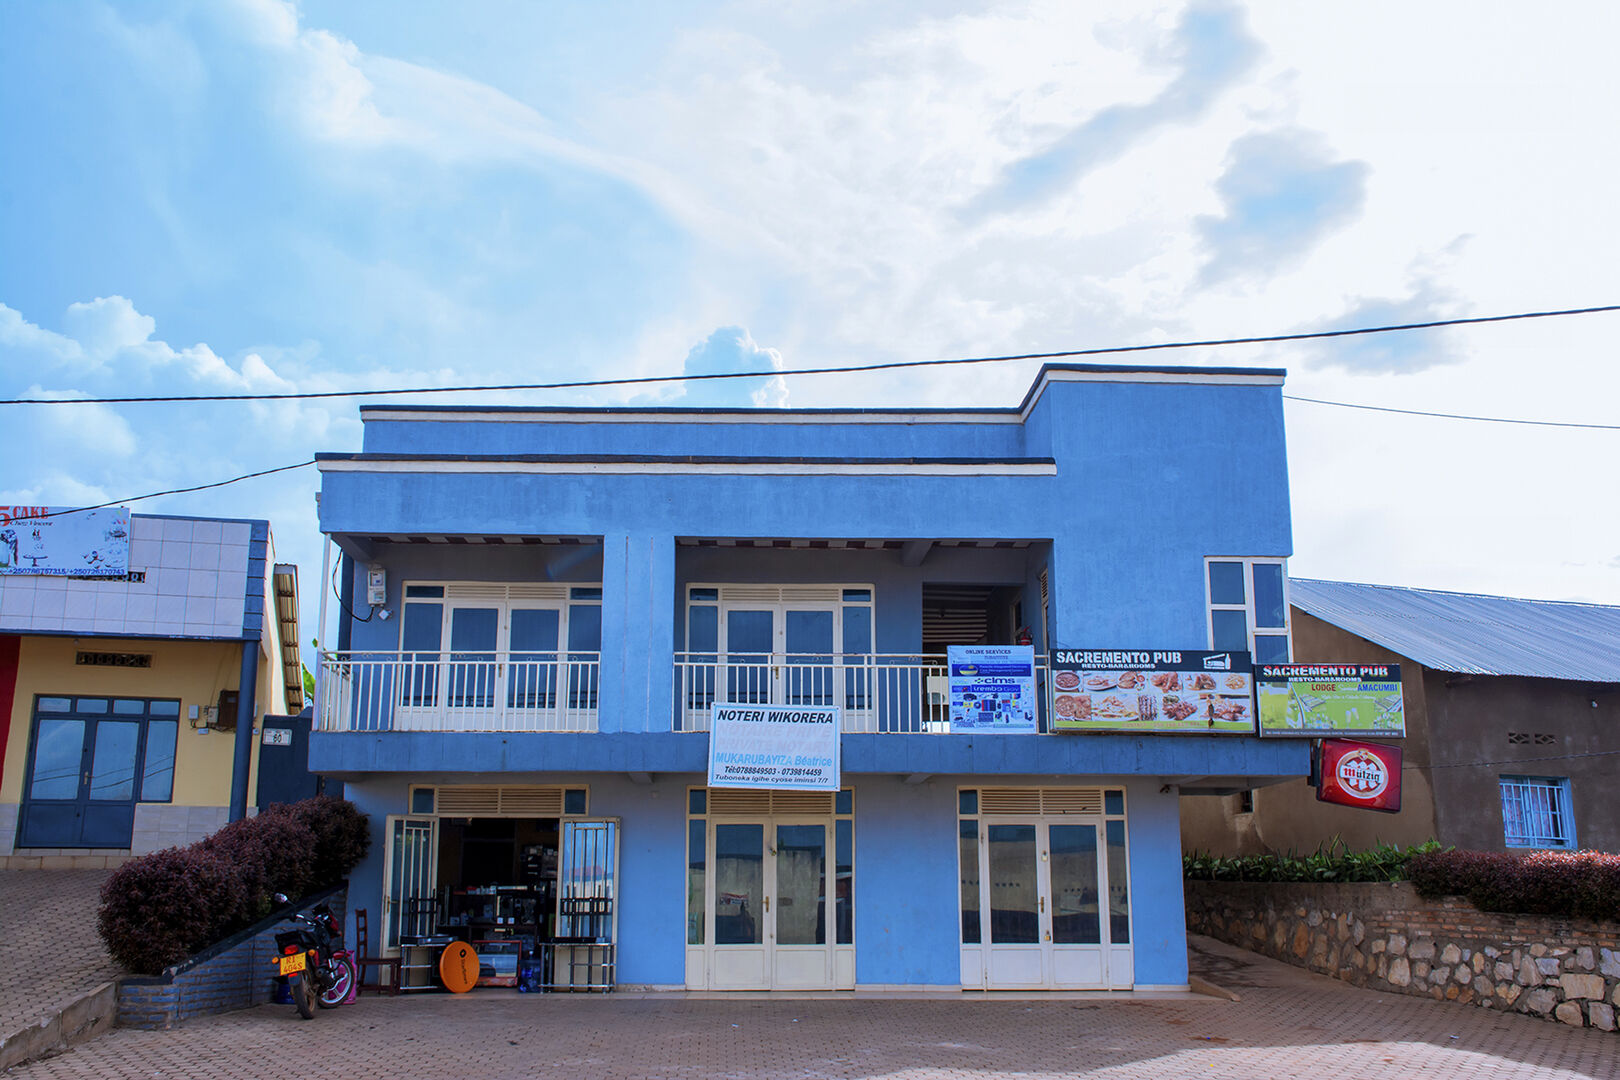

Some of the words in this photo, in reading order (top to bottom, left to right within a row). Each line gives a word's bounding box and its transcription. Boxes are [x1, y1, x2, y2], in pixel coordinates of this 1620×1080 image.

[13, 506, 48, 519] CAKE
[1056, 651, 1150, 664] SACREMENTO
[1153, 652, 1182, 664] PUB
[1263, 665, 1357, 677] SACREMENTO
[1359, 665, 1389, 677] PUB
[1311, 683, 1337, 692] LODGE
[1357, 683, 1398, 692] AMACUMBI
[717, 709, 765, 722] NOTERI
[767, 711, 833, 724] WIKORERA
[716, 752, 793, 766] MUKARUBAYIZA
[794, 755, 833, 767] Béatrice
[781, 768, 823, 777] 0739814459
[751, 775, 770, 783] igihe
